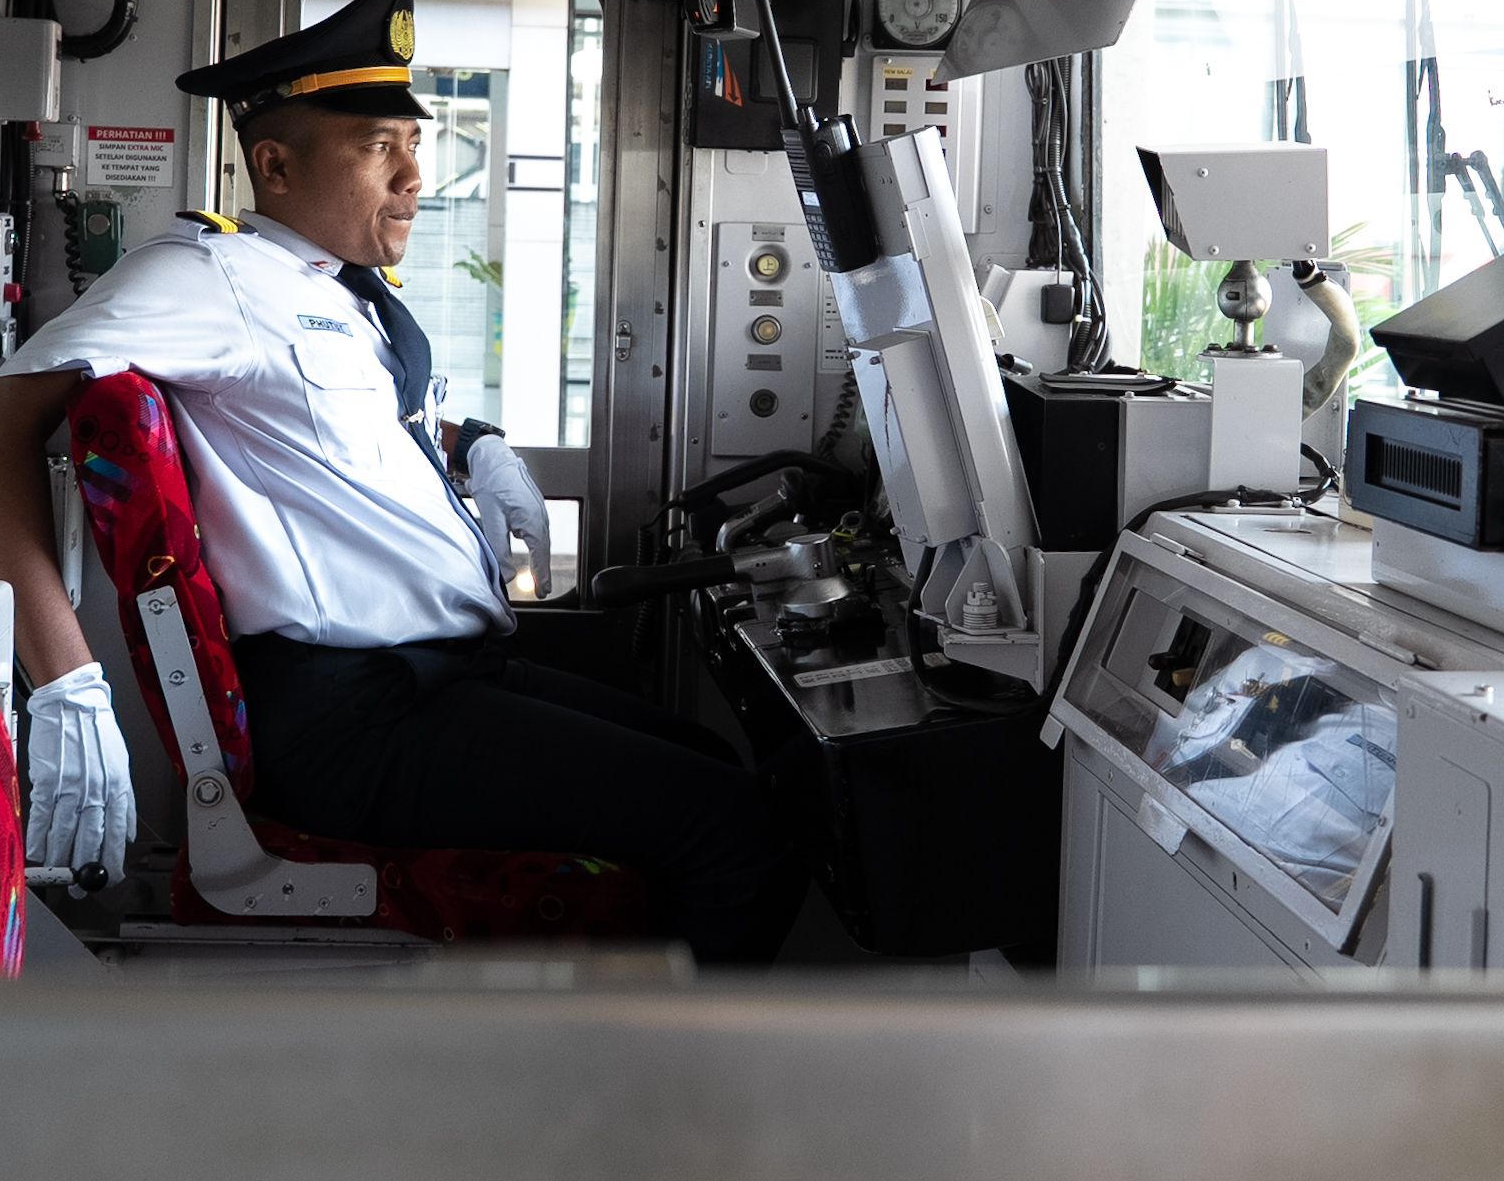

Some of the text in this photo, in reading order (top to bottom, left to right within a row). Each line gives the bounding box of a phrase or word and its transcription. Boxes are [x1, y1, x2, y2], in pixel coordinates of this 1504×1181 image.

[889, 13, 948, 23] 0 150
[914, 21, 921, 30] V
[96, 129, 166, 140] PERHATIAN !!!
[125, 154, 167, 162] DIGUNAKAN
